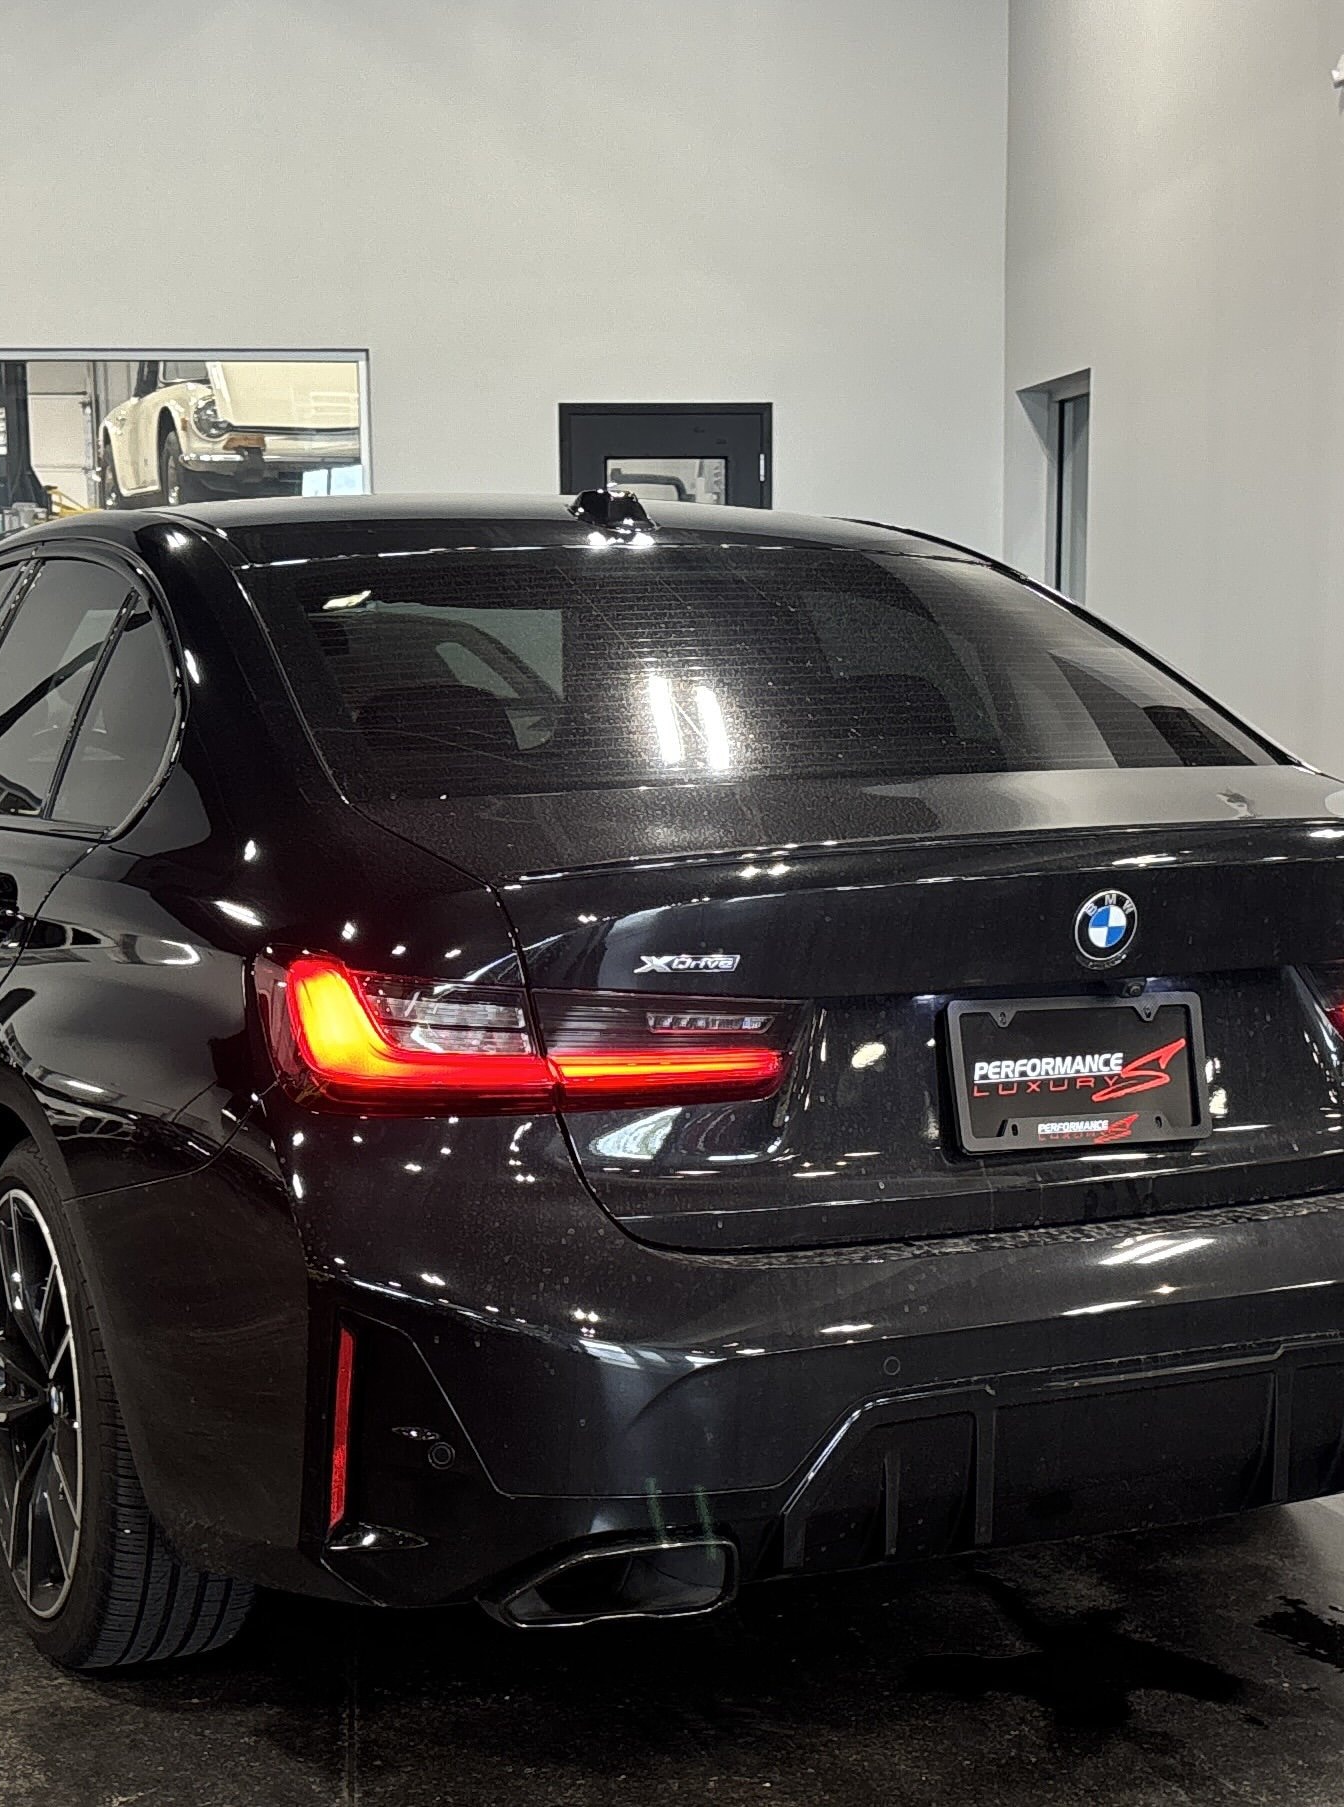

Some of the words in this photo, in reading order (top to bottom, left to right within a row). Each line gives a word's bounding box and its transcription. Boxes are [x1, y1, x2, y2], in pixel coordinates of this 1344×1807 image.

[1084, 893, 1135, 917] BMW
[974, 1053, 1123, 1080] PERFORMANCE
[973, 1076, 1119, 1097] LUXURY
[1038, 1120, 1109, 1134] PERFORMANCE
